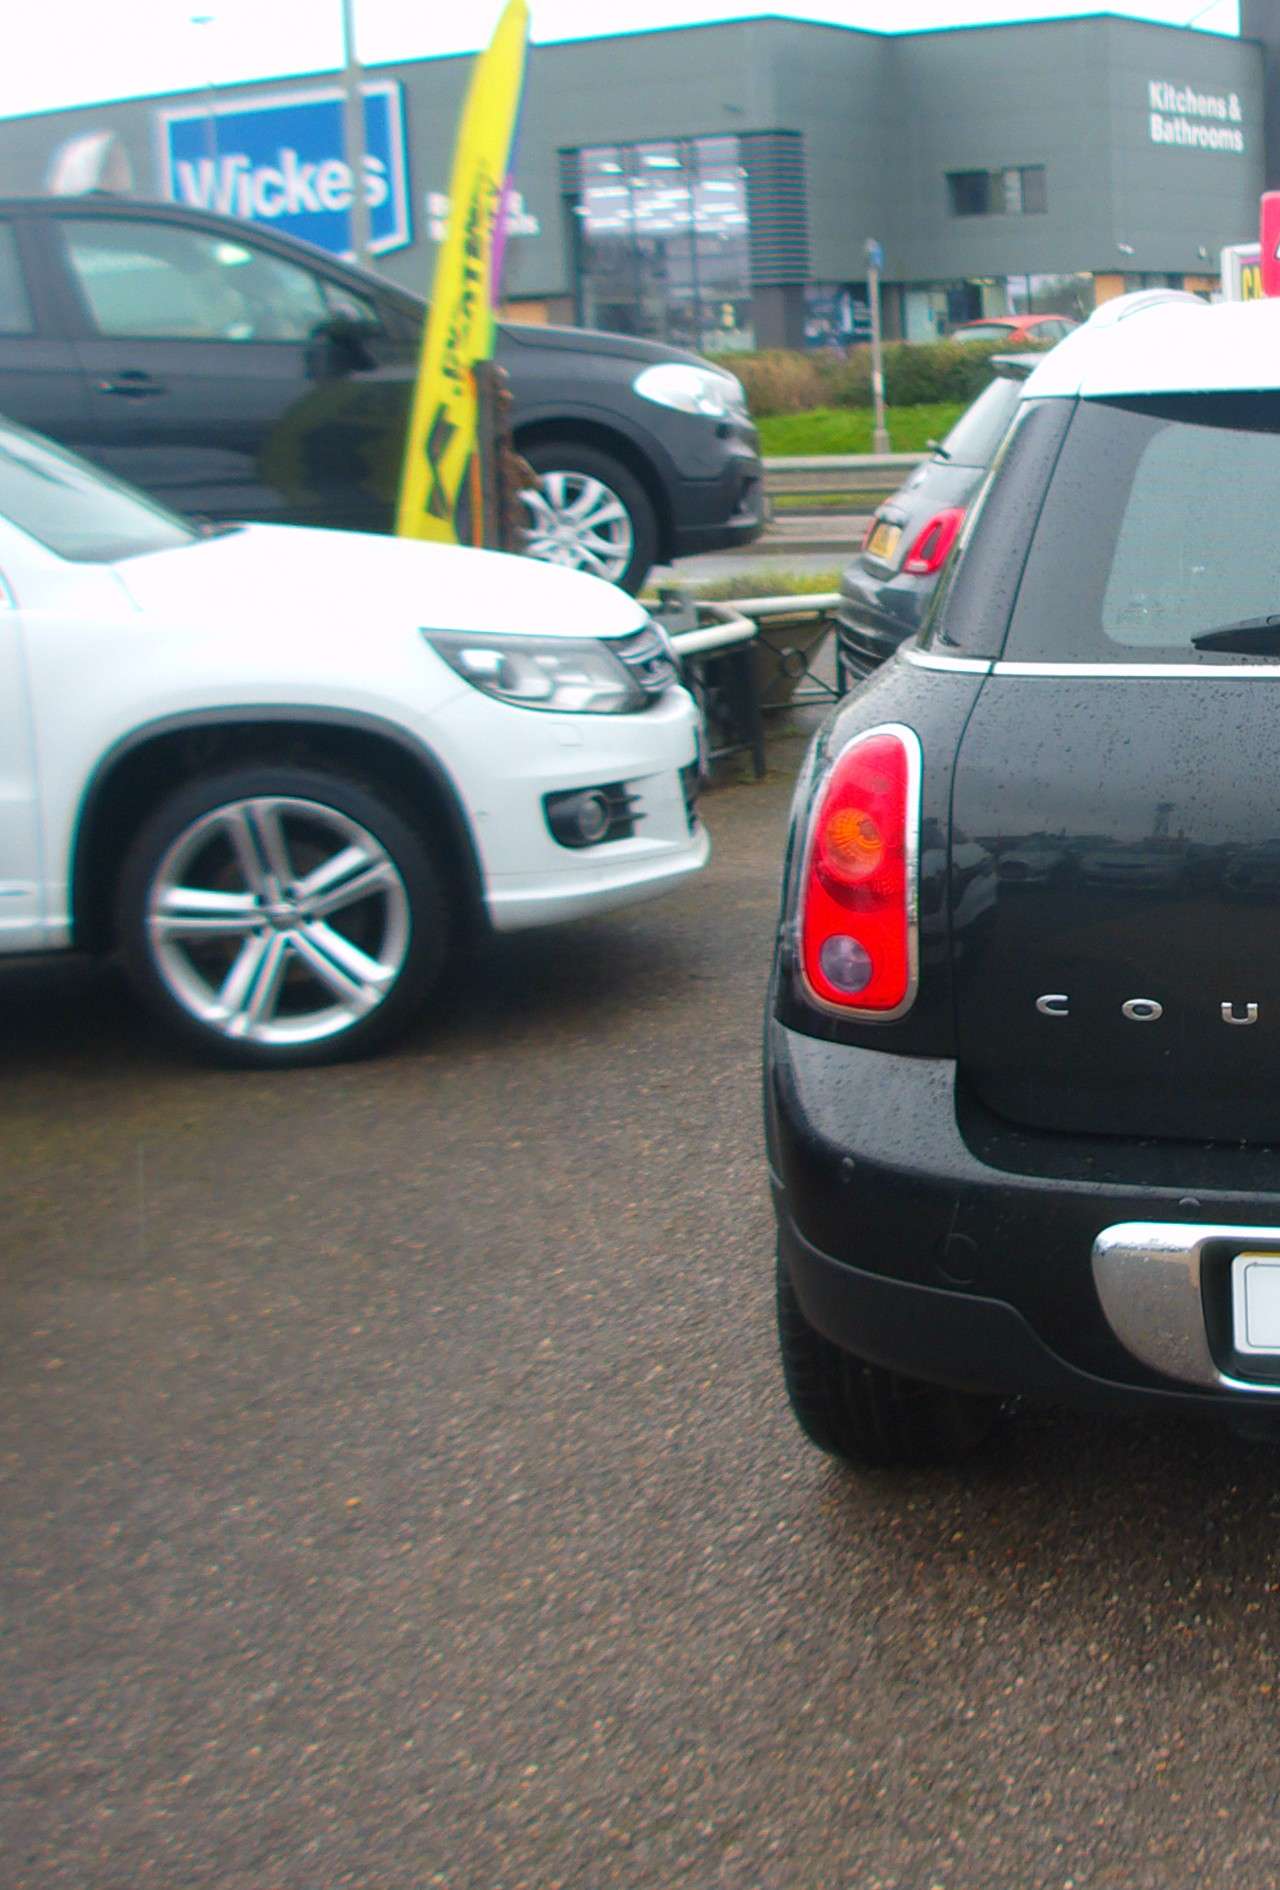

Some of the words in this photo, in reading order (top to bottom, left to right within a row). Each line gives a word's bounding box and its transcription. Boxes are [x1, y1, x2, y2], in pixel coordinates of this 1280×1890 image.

[1150, 81, 1227, 119] Kitchens
[1151, 113, 1244, 152] Bathrooms
[177, 147, 388, 218] Wickes
